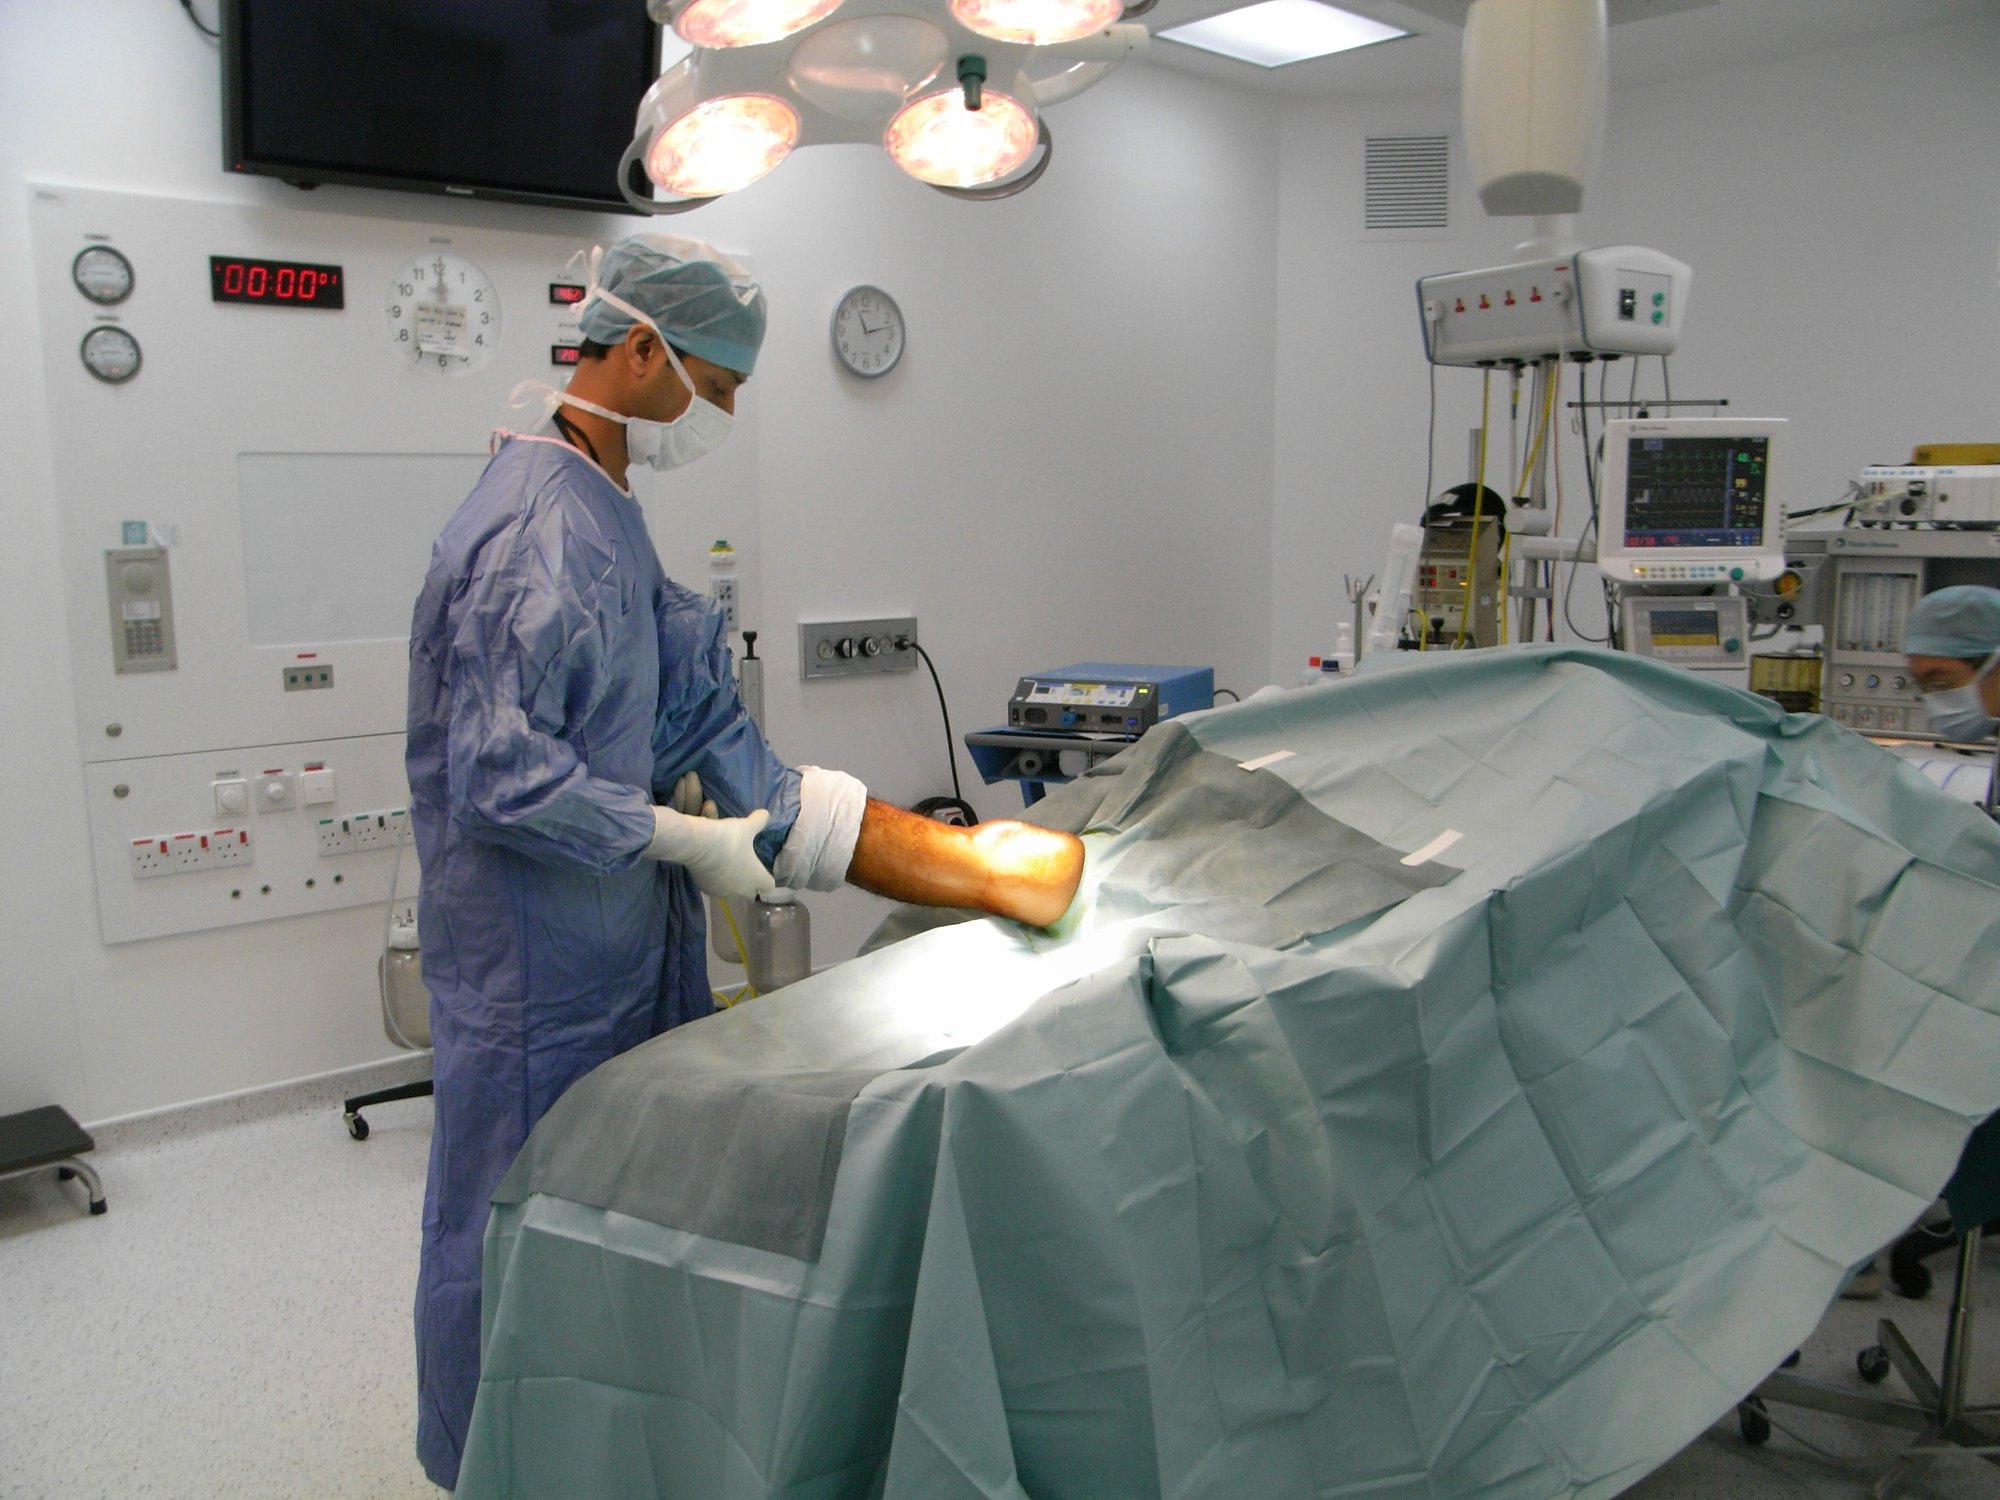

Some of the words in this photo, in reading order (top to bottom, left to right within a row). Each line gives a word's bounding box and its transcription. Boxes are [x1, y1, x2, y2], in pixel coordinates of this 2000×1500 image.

[413, 268, 424, 280] 11
[460, 271, 465, 284] 1
[223, 263, 318, 299] 00:00
[398, 283, 414, 297] 10
[474, 289, 483, 302] 2
[392, 305, 402, 318] 9
[481, 311, 490, 325] 3
[399, 329, 409, 342] 8
[474, 333, 484, 346] 4
[438, 354, 448, 368] 6
